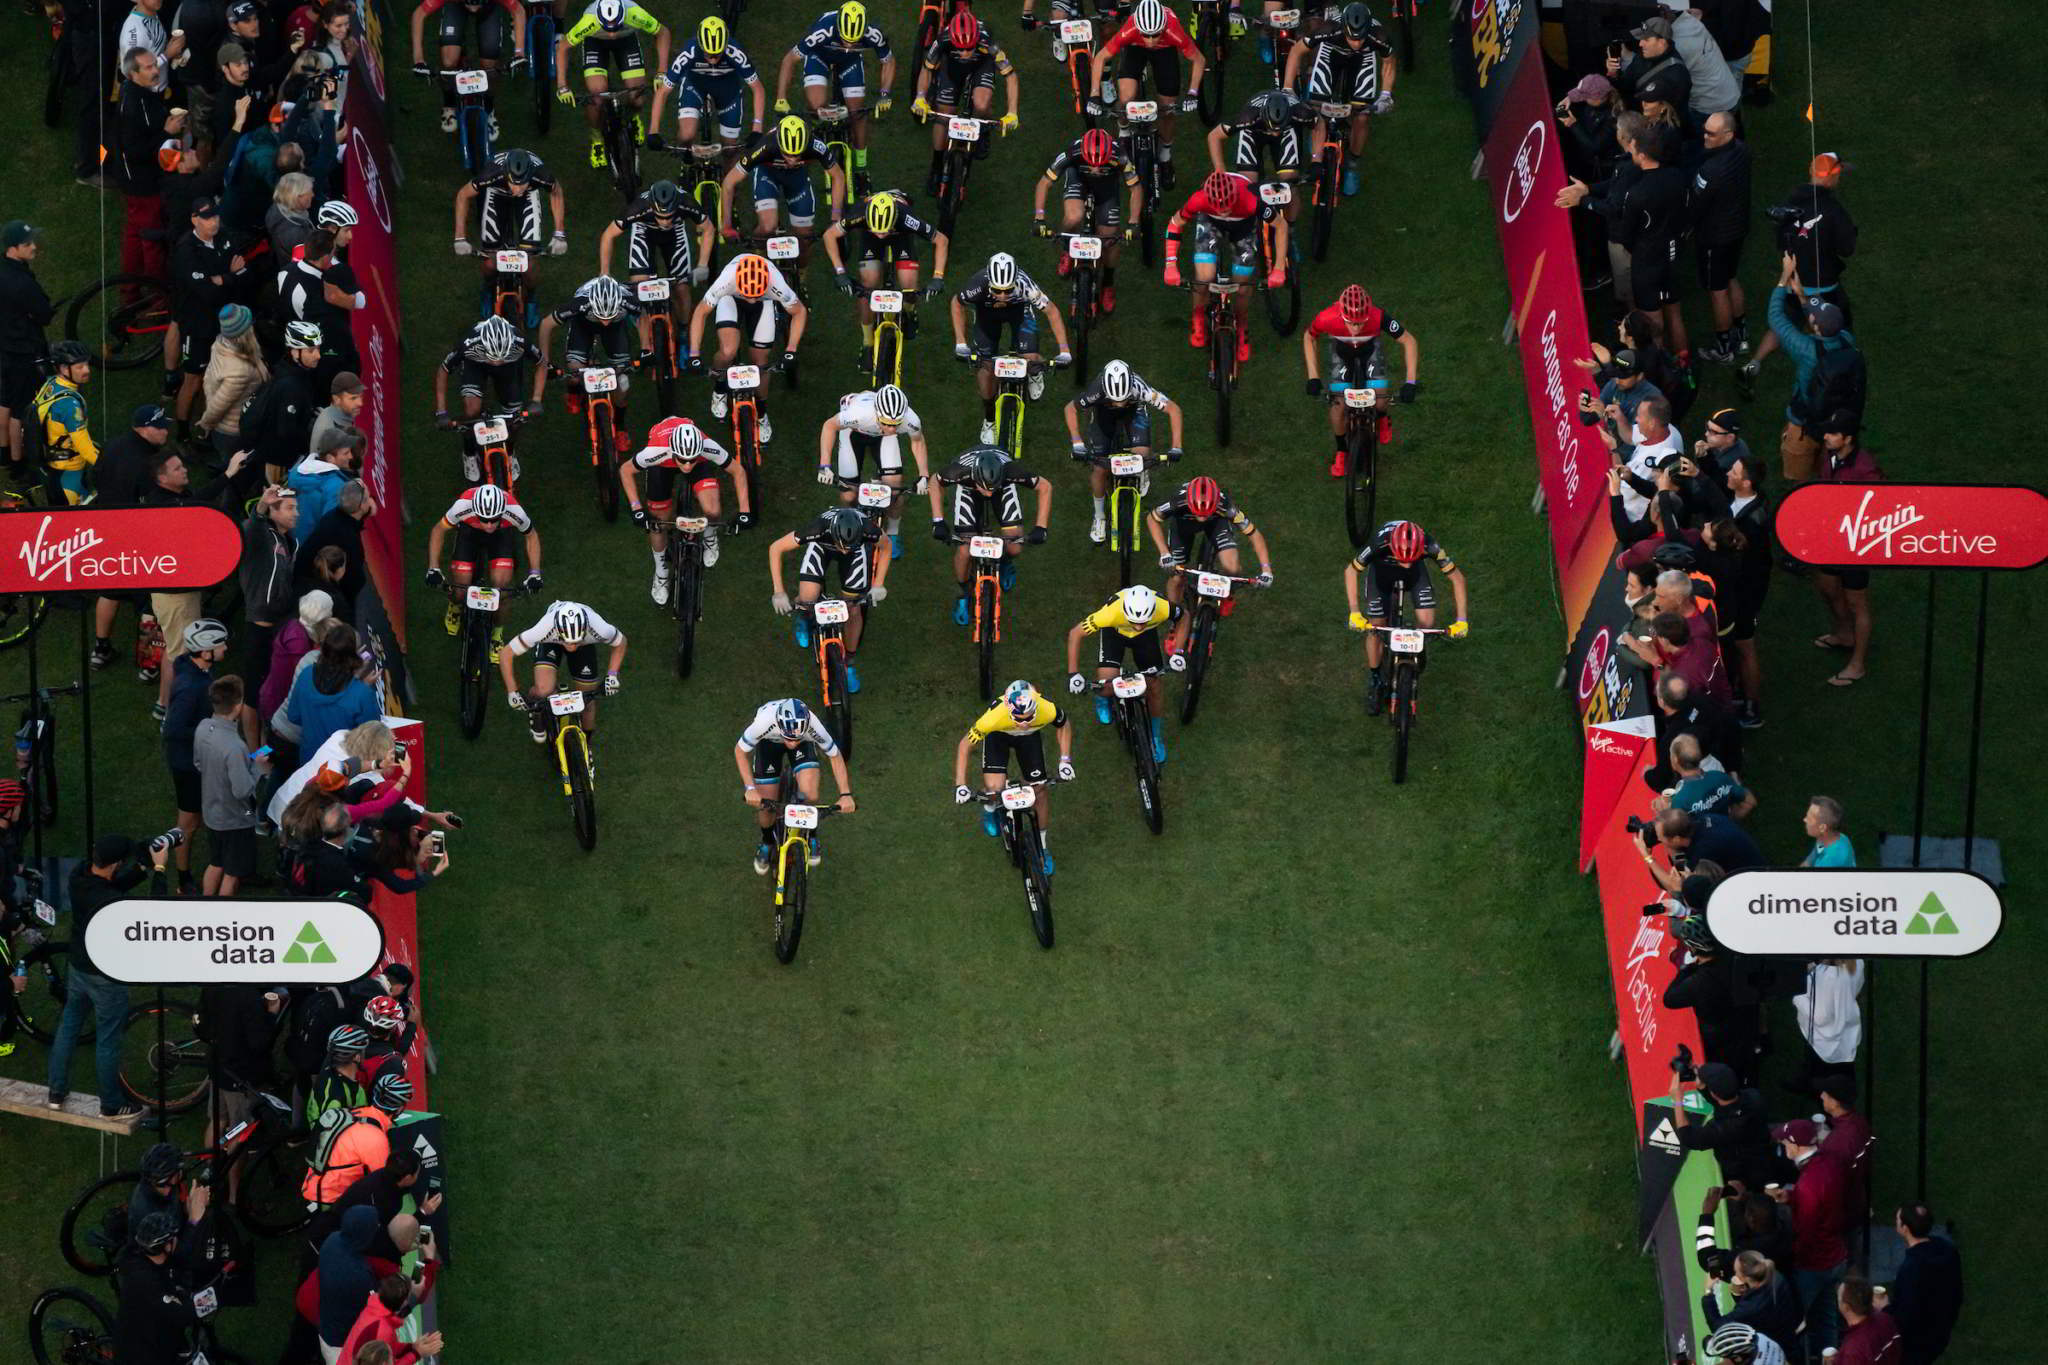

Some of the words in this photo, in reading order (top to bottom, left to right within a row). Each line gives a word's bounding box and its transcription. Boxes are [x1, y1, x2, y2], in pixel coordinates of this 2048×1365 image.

[804, 25, 834, 48] DSV
[671, 46, 696, 74] DSV
[725, 44, 751, 69] DSV
[1517, 145, 1533, 197] absa
[1542, 309, 1566, 418] Conquer
[1557, 412, 1570, 451] as
[1563, 438, 1579, 508] One.
[1839, 490, 1924, 558] Virgin
[19, 515, 103, 582] Virgin
[1898, 530, 1998, 554] active
[80, 551, 177, 577] active
[1206, 587, 1220, 595] 10-2
[1591, 732, 1615, 753] Virgin
[1606, 745, 1634, 757] active
[1748, 893, 1897, 915] dimension
[124, 920, 276, 942] dimension
[1833, 914, 1898, 936] data
[210, 943, 275, 965] data
[1632, 968, 1657, 1054] active
